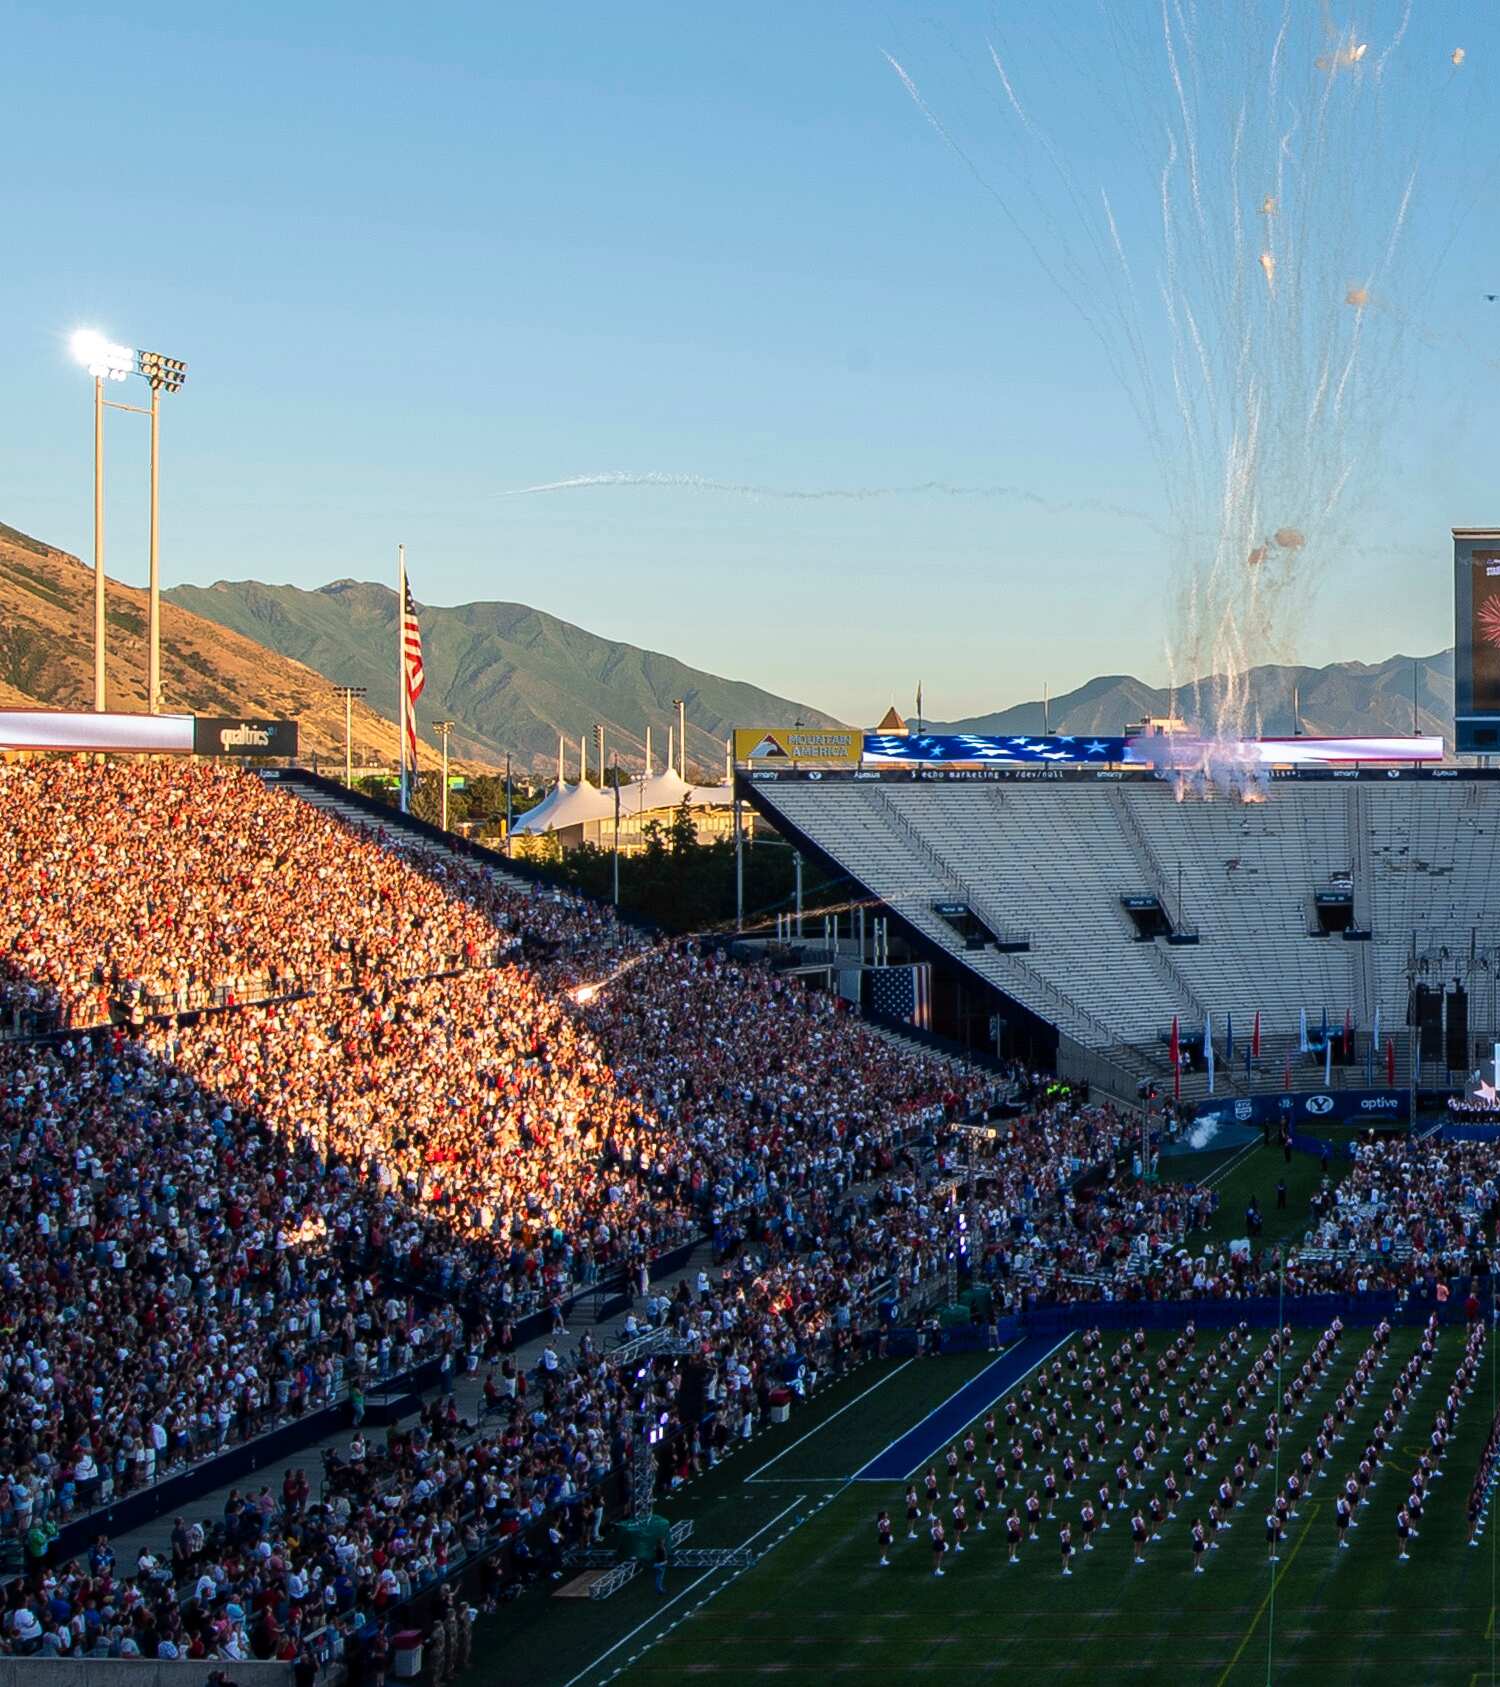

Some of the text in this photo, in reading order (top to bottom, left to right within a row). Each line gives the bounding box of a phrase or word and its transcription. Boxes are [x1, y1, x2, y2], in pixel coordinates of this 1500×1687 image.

[221, 723, 269, 752] qualtrics
[787, 735, 852, 745] MOUNTAIN
[792, 747, 849, 757] AMERICA
[921, 770, 945, 778] echo
[949, 770, 999, 779] marketing
[1015, 770, 1064, 778] /dev/null
